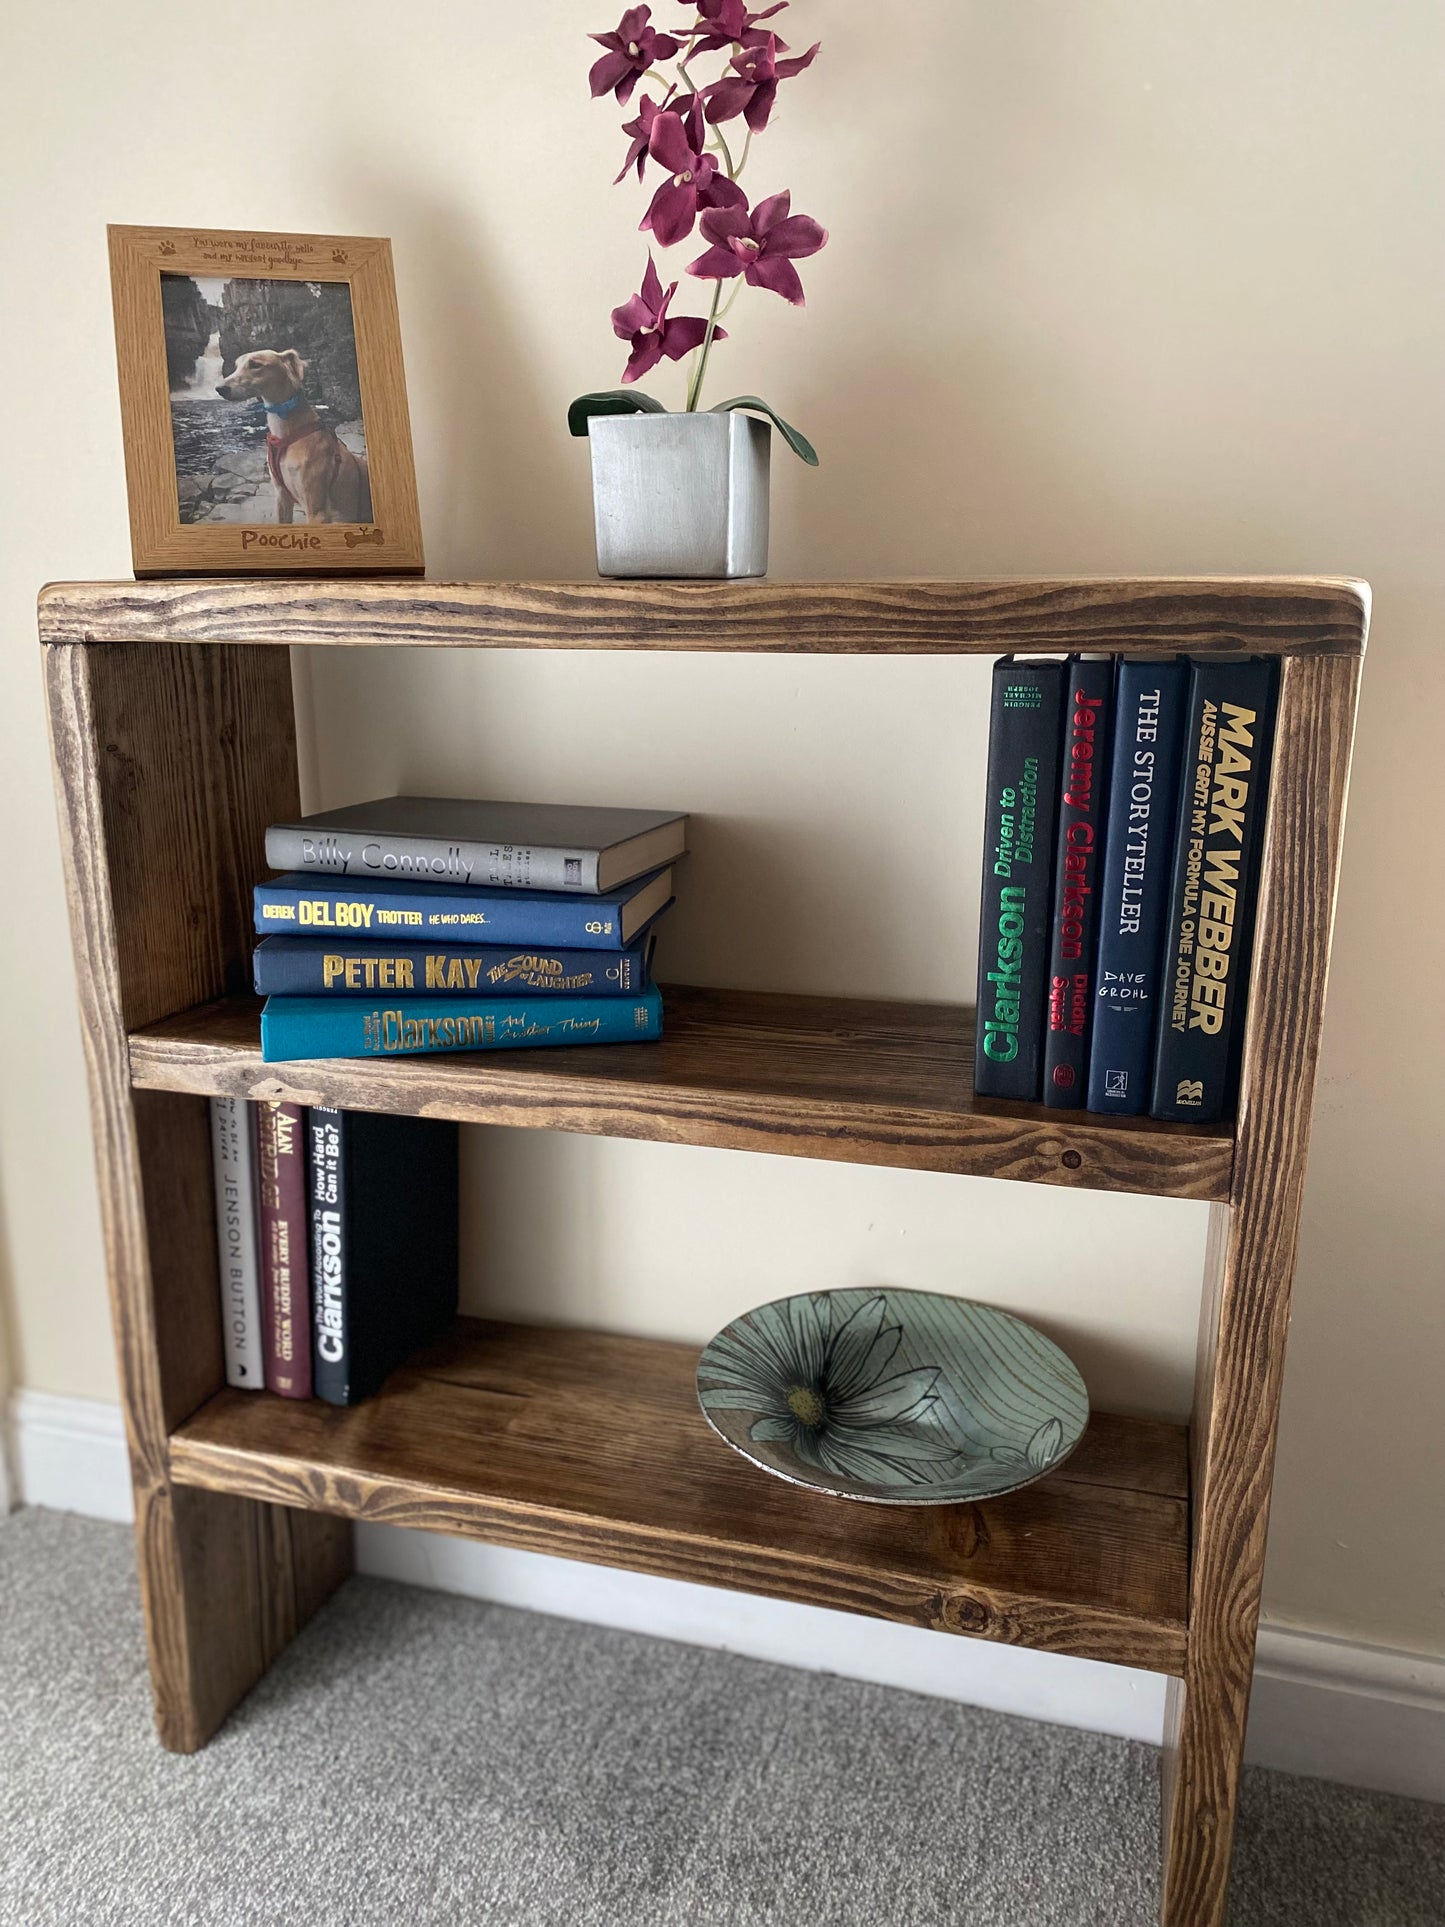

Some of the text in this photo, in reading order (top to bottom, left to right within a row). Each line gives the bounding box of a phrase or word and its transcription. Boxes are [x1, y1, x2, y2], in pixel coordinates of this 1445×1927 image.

[236, 241, 249, 252] my
[241, 530, 321, 549] Poochie
[1198, 698, 1218, 763] AUSSIE
[994, 787, 1016, 878] Driven to
[1015, 757, 1039, 864] Distraction
[1060, 688, 1103, 960] Jeremy Clarkson
[1119, 689, 1160, 935] THE STORYTELLER
[1190, 809, 1207, 836] MY
[302, 838, 351, 874] Billy
[362, 843, 474, 883] Connolly
[1182, 838, 1204, 917] FORMULA
[1188, 701, 1257, 1035] MARK WEBBER
[262, 904, 296, 920] DEREK
[376, 910, 423, 925] TROTTER
[428, 913, 440, 925] HE
[441, 913, 459, 924] WHO
[1178, 919, 1195, 955] ONE
[323, 954, 482, 989] PETER KAY
[486, 954, 563, 984] THE SOUND
[527, 971, 594, 989] LAUGHTER
[983, 886, 1025, 1062] Clarkson
[1104, 971, 1146, 983] DAVE
[1049, 975, 1069, 1031] Squat
[1098, 986, 1149, 999] GROHL
[1171, 956, 1191, 1033] JOURNEY
[381, 1010, 484, 1051] Clarkson
[557, 1017, 607, 1035] Thing
[277, 1111, 298, 1155] ALAN
[312, 1126, 325, 1202] How Hard
[325, 1123, 339, 1204] Can it Be?
[224, 1173, 247, 1350] JENSON BUTTON
[278, 1219, 289, 1265] EVERY
[318, 1211, 344, 1363] Clarkson
[281, 1319, 293, 1361] WORD
